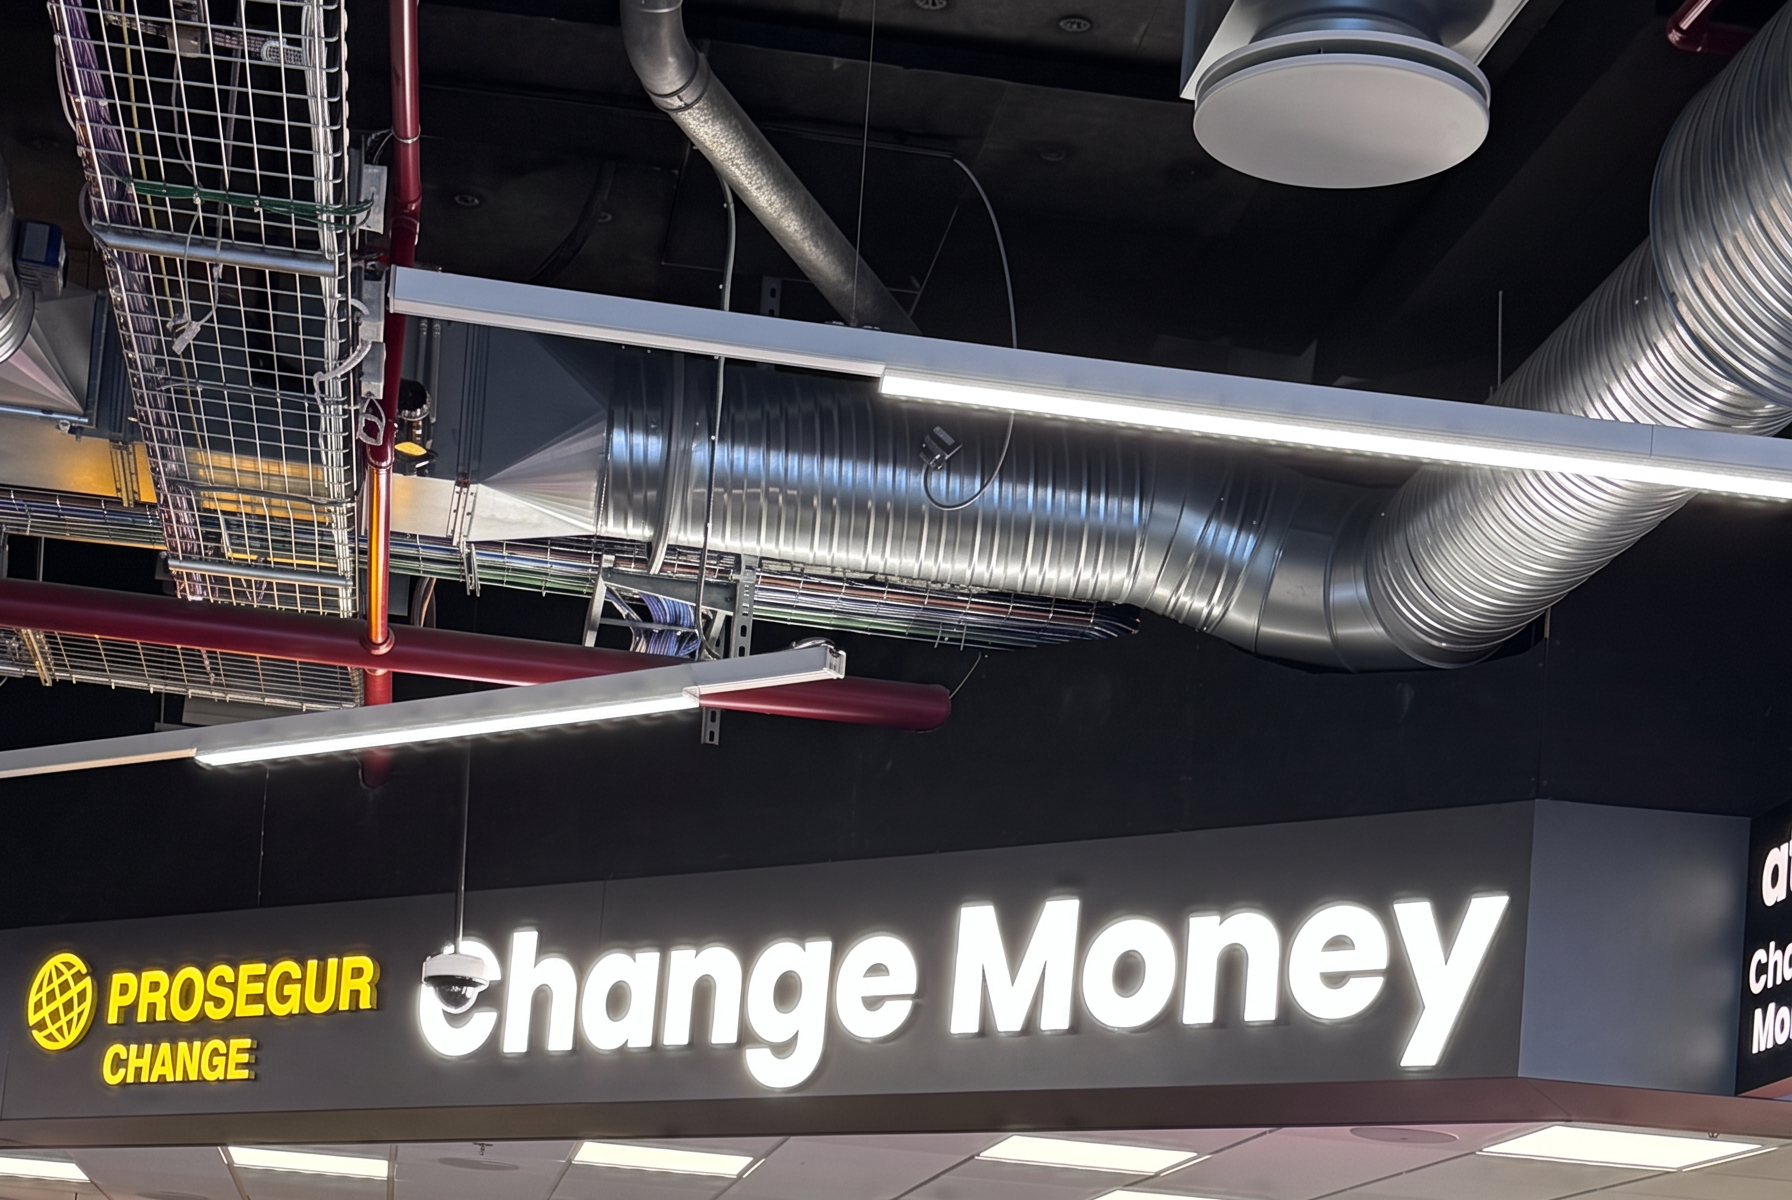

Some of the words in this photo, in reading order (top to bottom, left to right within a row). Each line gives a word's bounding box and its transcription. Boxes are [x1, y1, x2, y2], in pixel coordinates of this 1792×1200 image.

[107, 954, 376, 1025] PROSEGUR
[418, 927, 916, 1090] Change
[950, 895, 1510, 1067] Money
[102, 1037, 253, 1086] CHANGE
